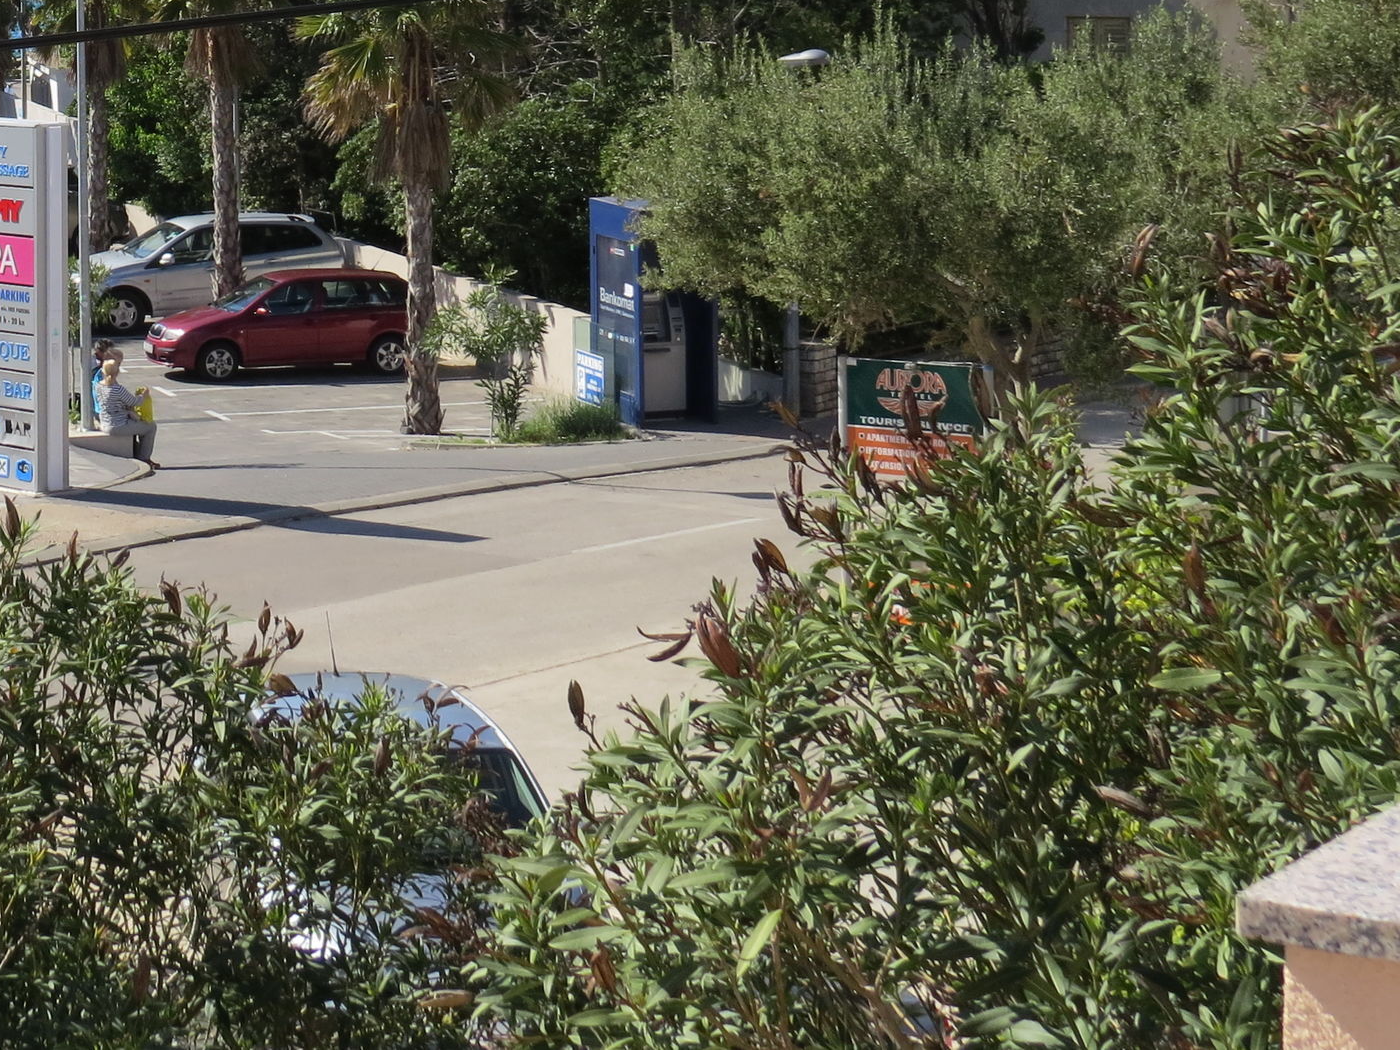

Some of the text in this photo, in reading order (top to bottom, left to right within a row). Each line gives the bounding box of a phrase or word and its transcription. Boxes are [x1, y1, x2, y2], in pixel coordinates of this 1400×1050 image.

[599, 286, 635, 312] Bankomat
[4, 380, 33, 400] BAR
[875, 368, 947, 395] AURORA
[5, 419, 32, 438] BAR
[860, 416, 905, 427] TOURIS
